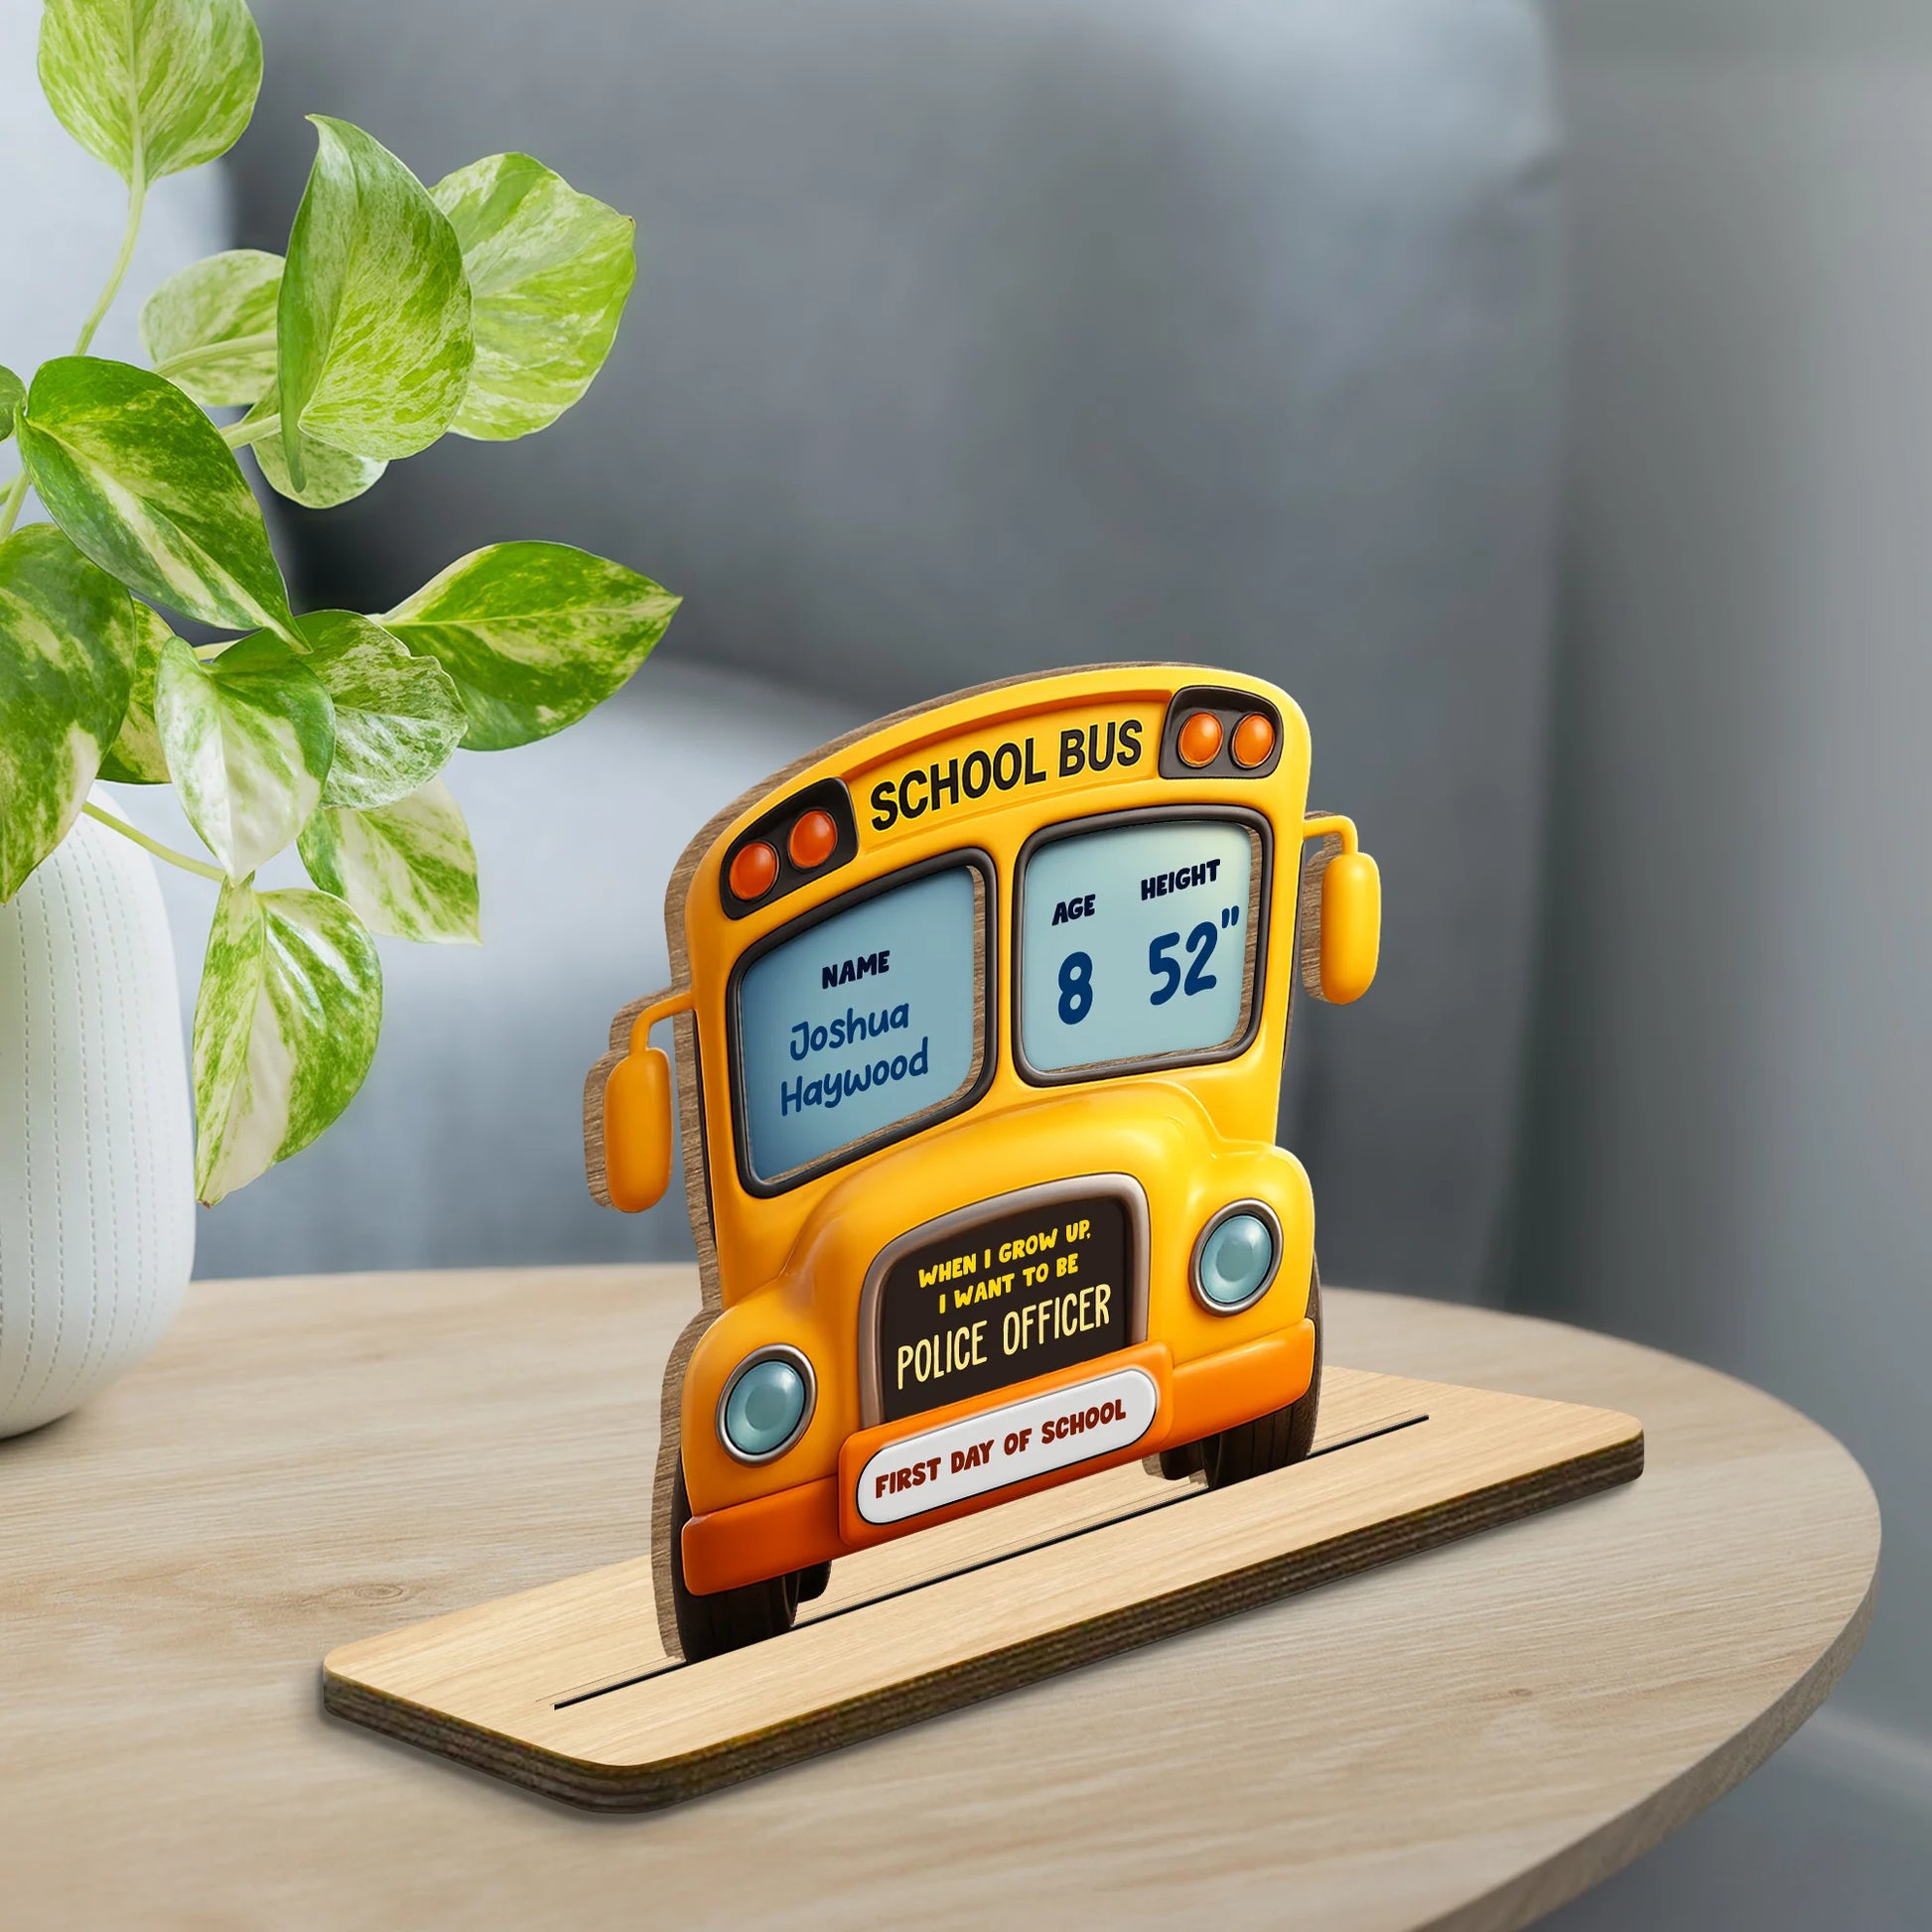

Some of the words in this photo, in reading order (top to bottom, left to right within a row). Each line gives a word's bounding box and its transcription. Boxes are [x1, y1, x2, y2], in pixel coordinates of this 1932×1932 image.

[871, 738, 1046, 831] SCHOOL
[1058, 719, 1143, 777] BUS
[1051, 894, 1096, 926] AGE
[1141, 859, 1221, 900] HEIGHT
[822, 950, 891, 989] NAME
[1058, 951, 1093, 1025] 8
[1149, 905, 1240, 1006] 52"
[790, 1003, 909, 1060] Joshua
[781, 1035, 928, 1117] Haywood
[918, 1253, 976, 1288] WHEN
[984, 1249, 991, 1269] I
[999, 1228, 1058, 1263] GROW
[1065, 1219, 1091, 1243] UP,
[939, 1294, 946, 1314] I
[954, 1273, 1015, 1309] WANT
[1023, 1263, 1049, 1287] TO
[1056, 1253, 1079, 1278] BE
[897, 1319, 988, 1390] POLICE
[1003, 1284, 1111, 1356] OFFICER
[875, 1456, 941, 1499] FIRST
[950, 1440, 995, 1474] DAY
[1003, 1428, 1033, 1455] OF
[1041, 1399, 1127, 1445] SCHOOL
